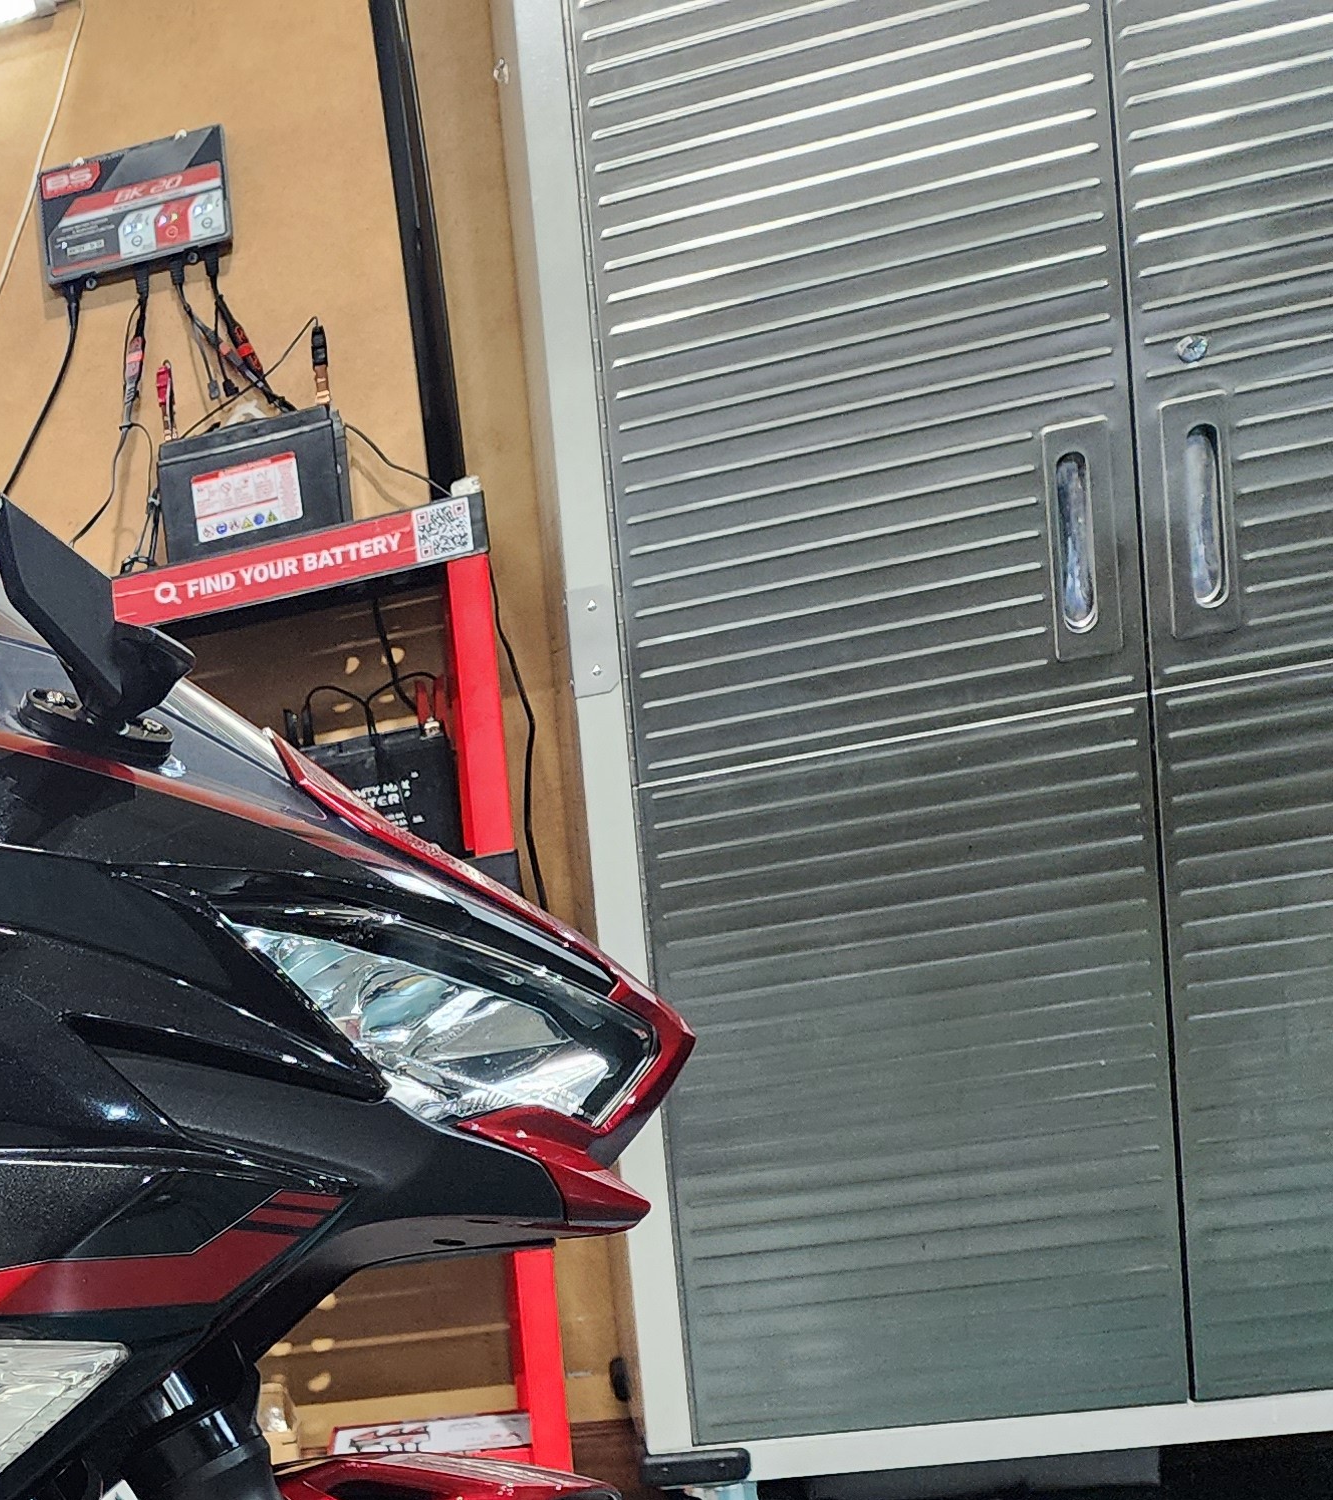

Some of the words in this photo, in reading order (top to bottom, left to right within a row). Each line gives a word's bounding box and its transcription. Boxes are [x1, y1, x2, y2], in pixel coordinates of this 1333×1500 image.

[150, 174, 183, 195] 20
[186, 571, 236, 599] FIND
[239, 556, 299, 587] YOUR
[302, 531, 402, 572] BATTERY
